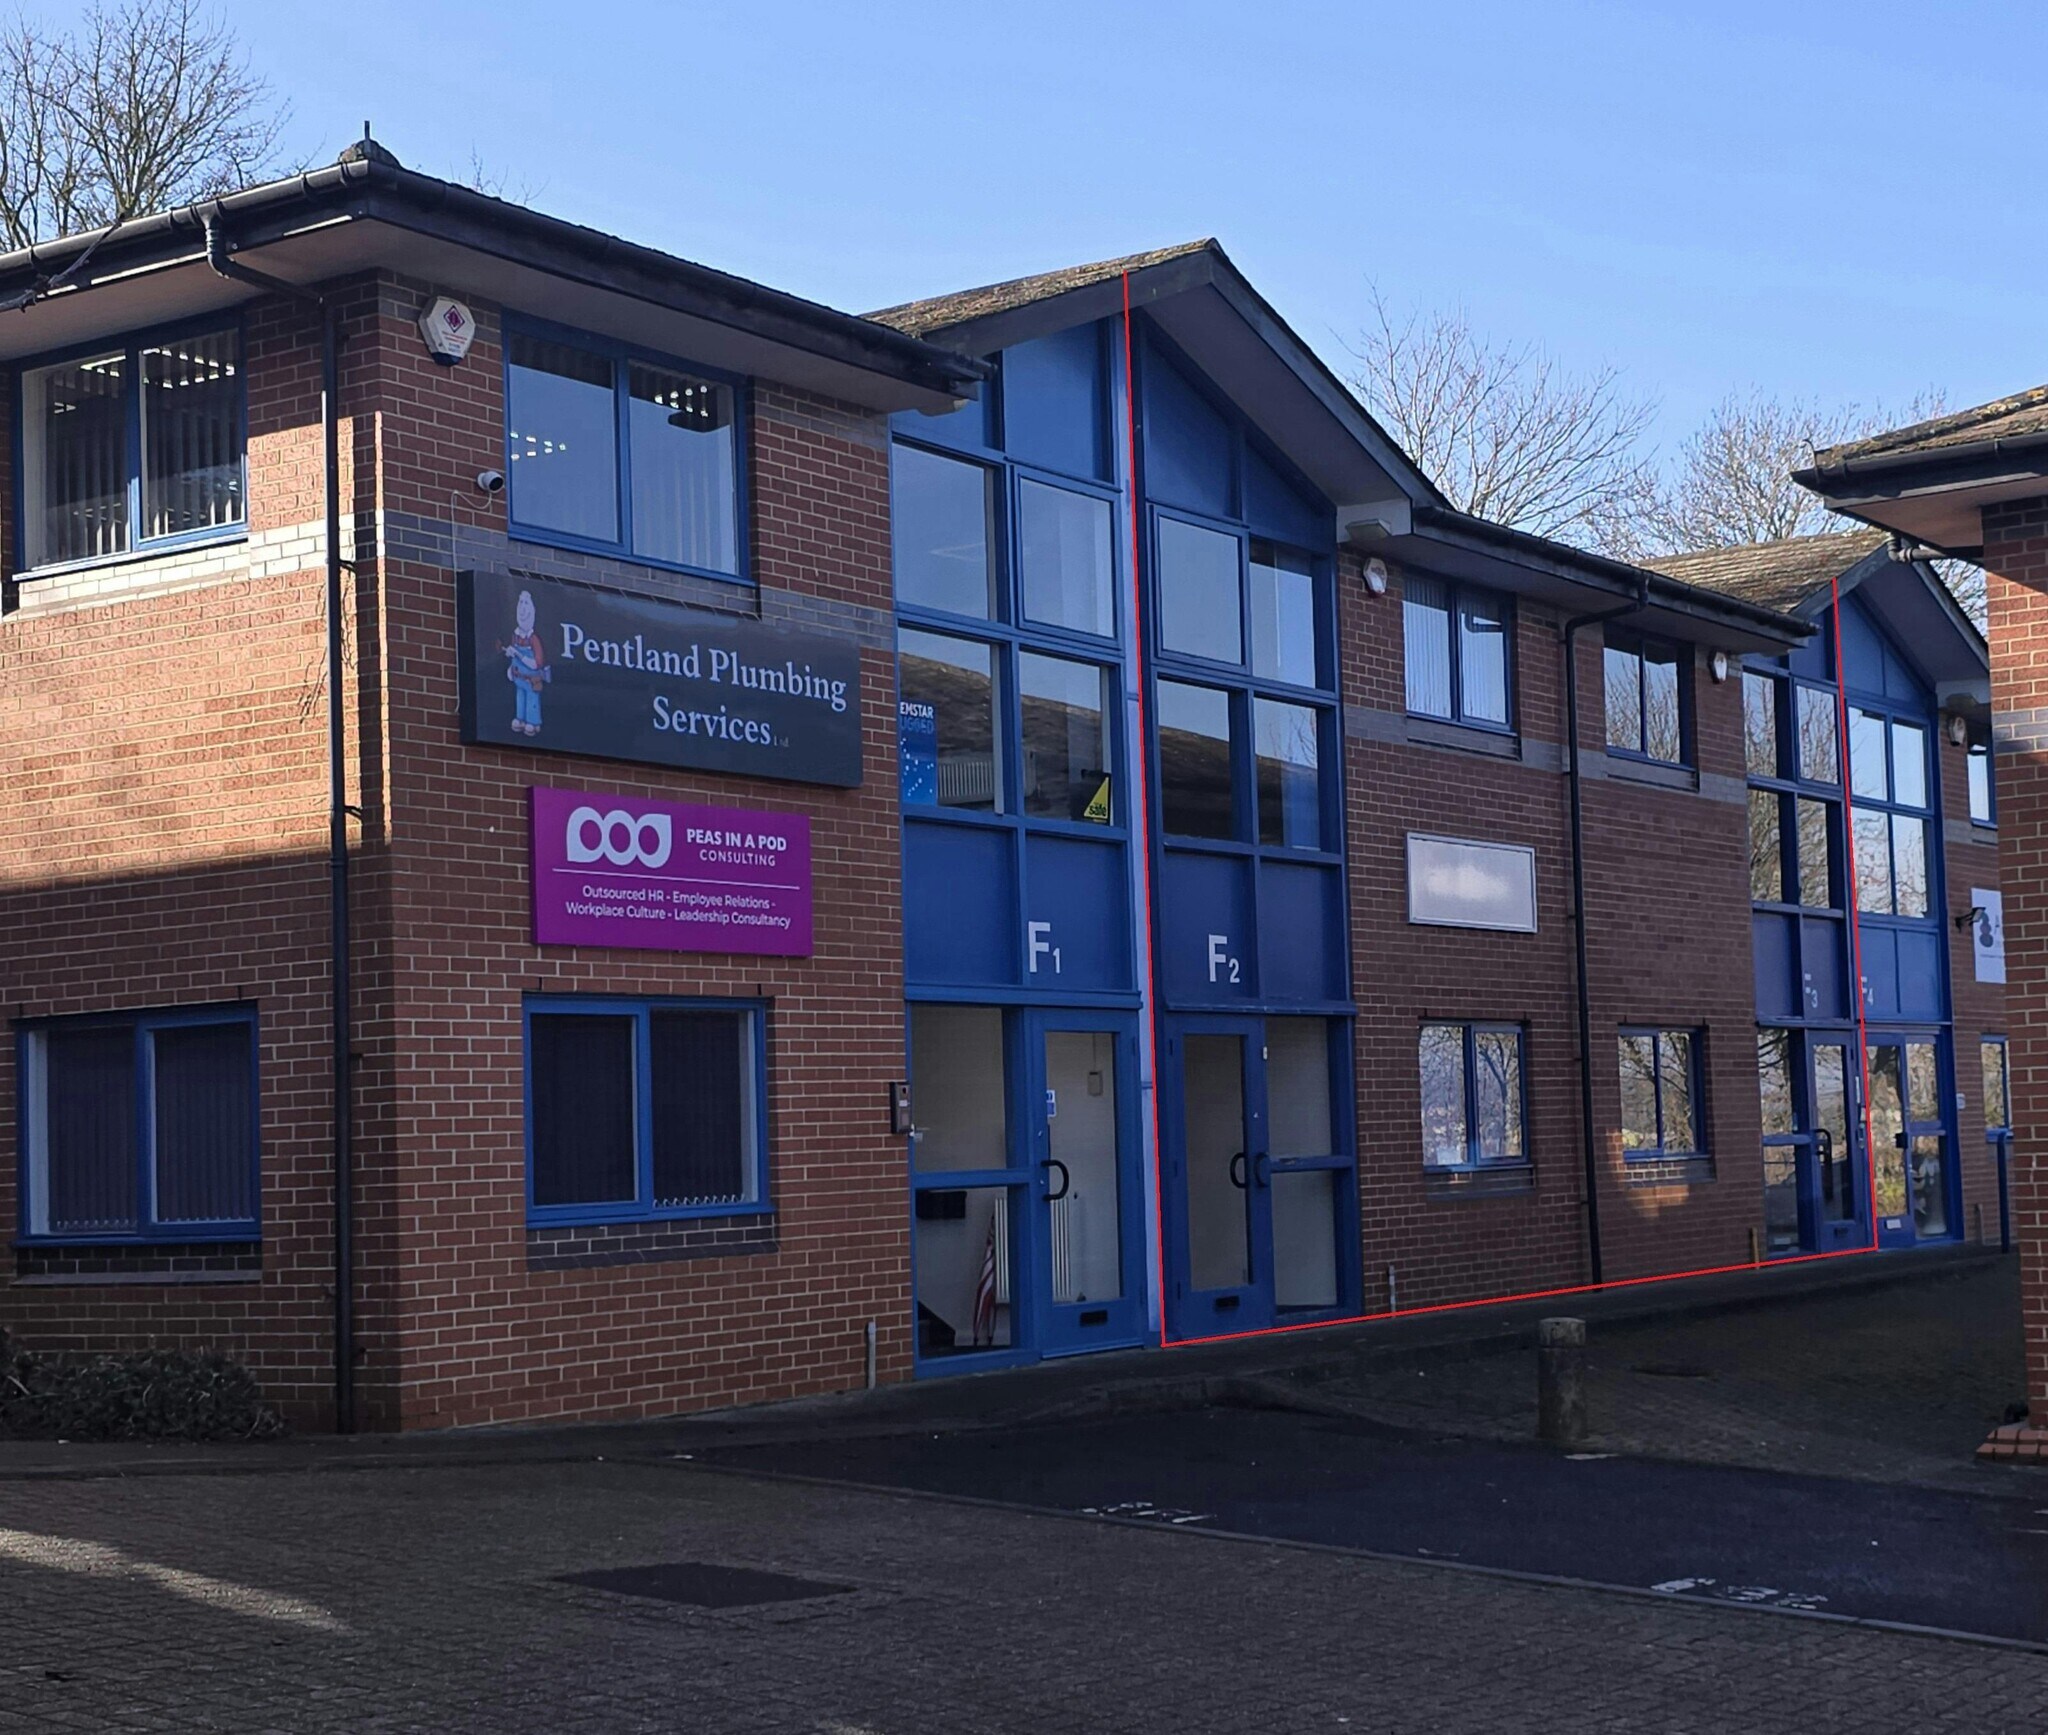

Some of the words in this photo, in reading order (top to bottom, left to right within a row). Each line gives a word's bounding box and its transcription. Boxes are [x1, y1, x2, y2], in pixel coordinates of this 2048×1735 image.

[560, 623, 701, 679] Pentland
[708, 648, 847, 712] Plumbing
[652, 696, 771, 745] Services
[686, 828, 722, 845] PEAS
[725, 833, 741, 847] IN
[744, 834, 756, 848] A
[758, 836, 787, 851] POD
[699, 849, 776, 867] CONSULTING
[582, 885, 645, 901] Outsourced
[648, 888, 664, 900] HR
[672, 891, 723, 907] Employee
[725, 895, 769, 909] Relations
[566, 902, 624, 918] Workplace
[626, 906, 666, 919] Culture
[674, 909, 730, 924] Leadership
[731, 912, 791, 930] Consultancy
